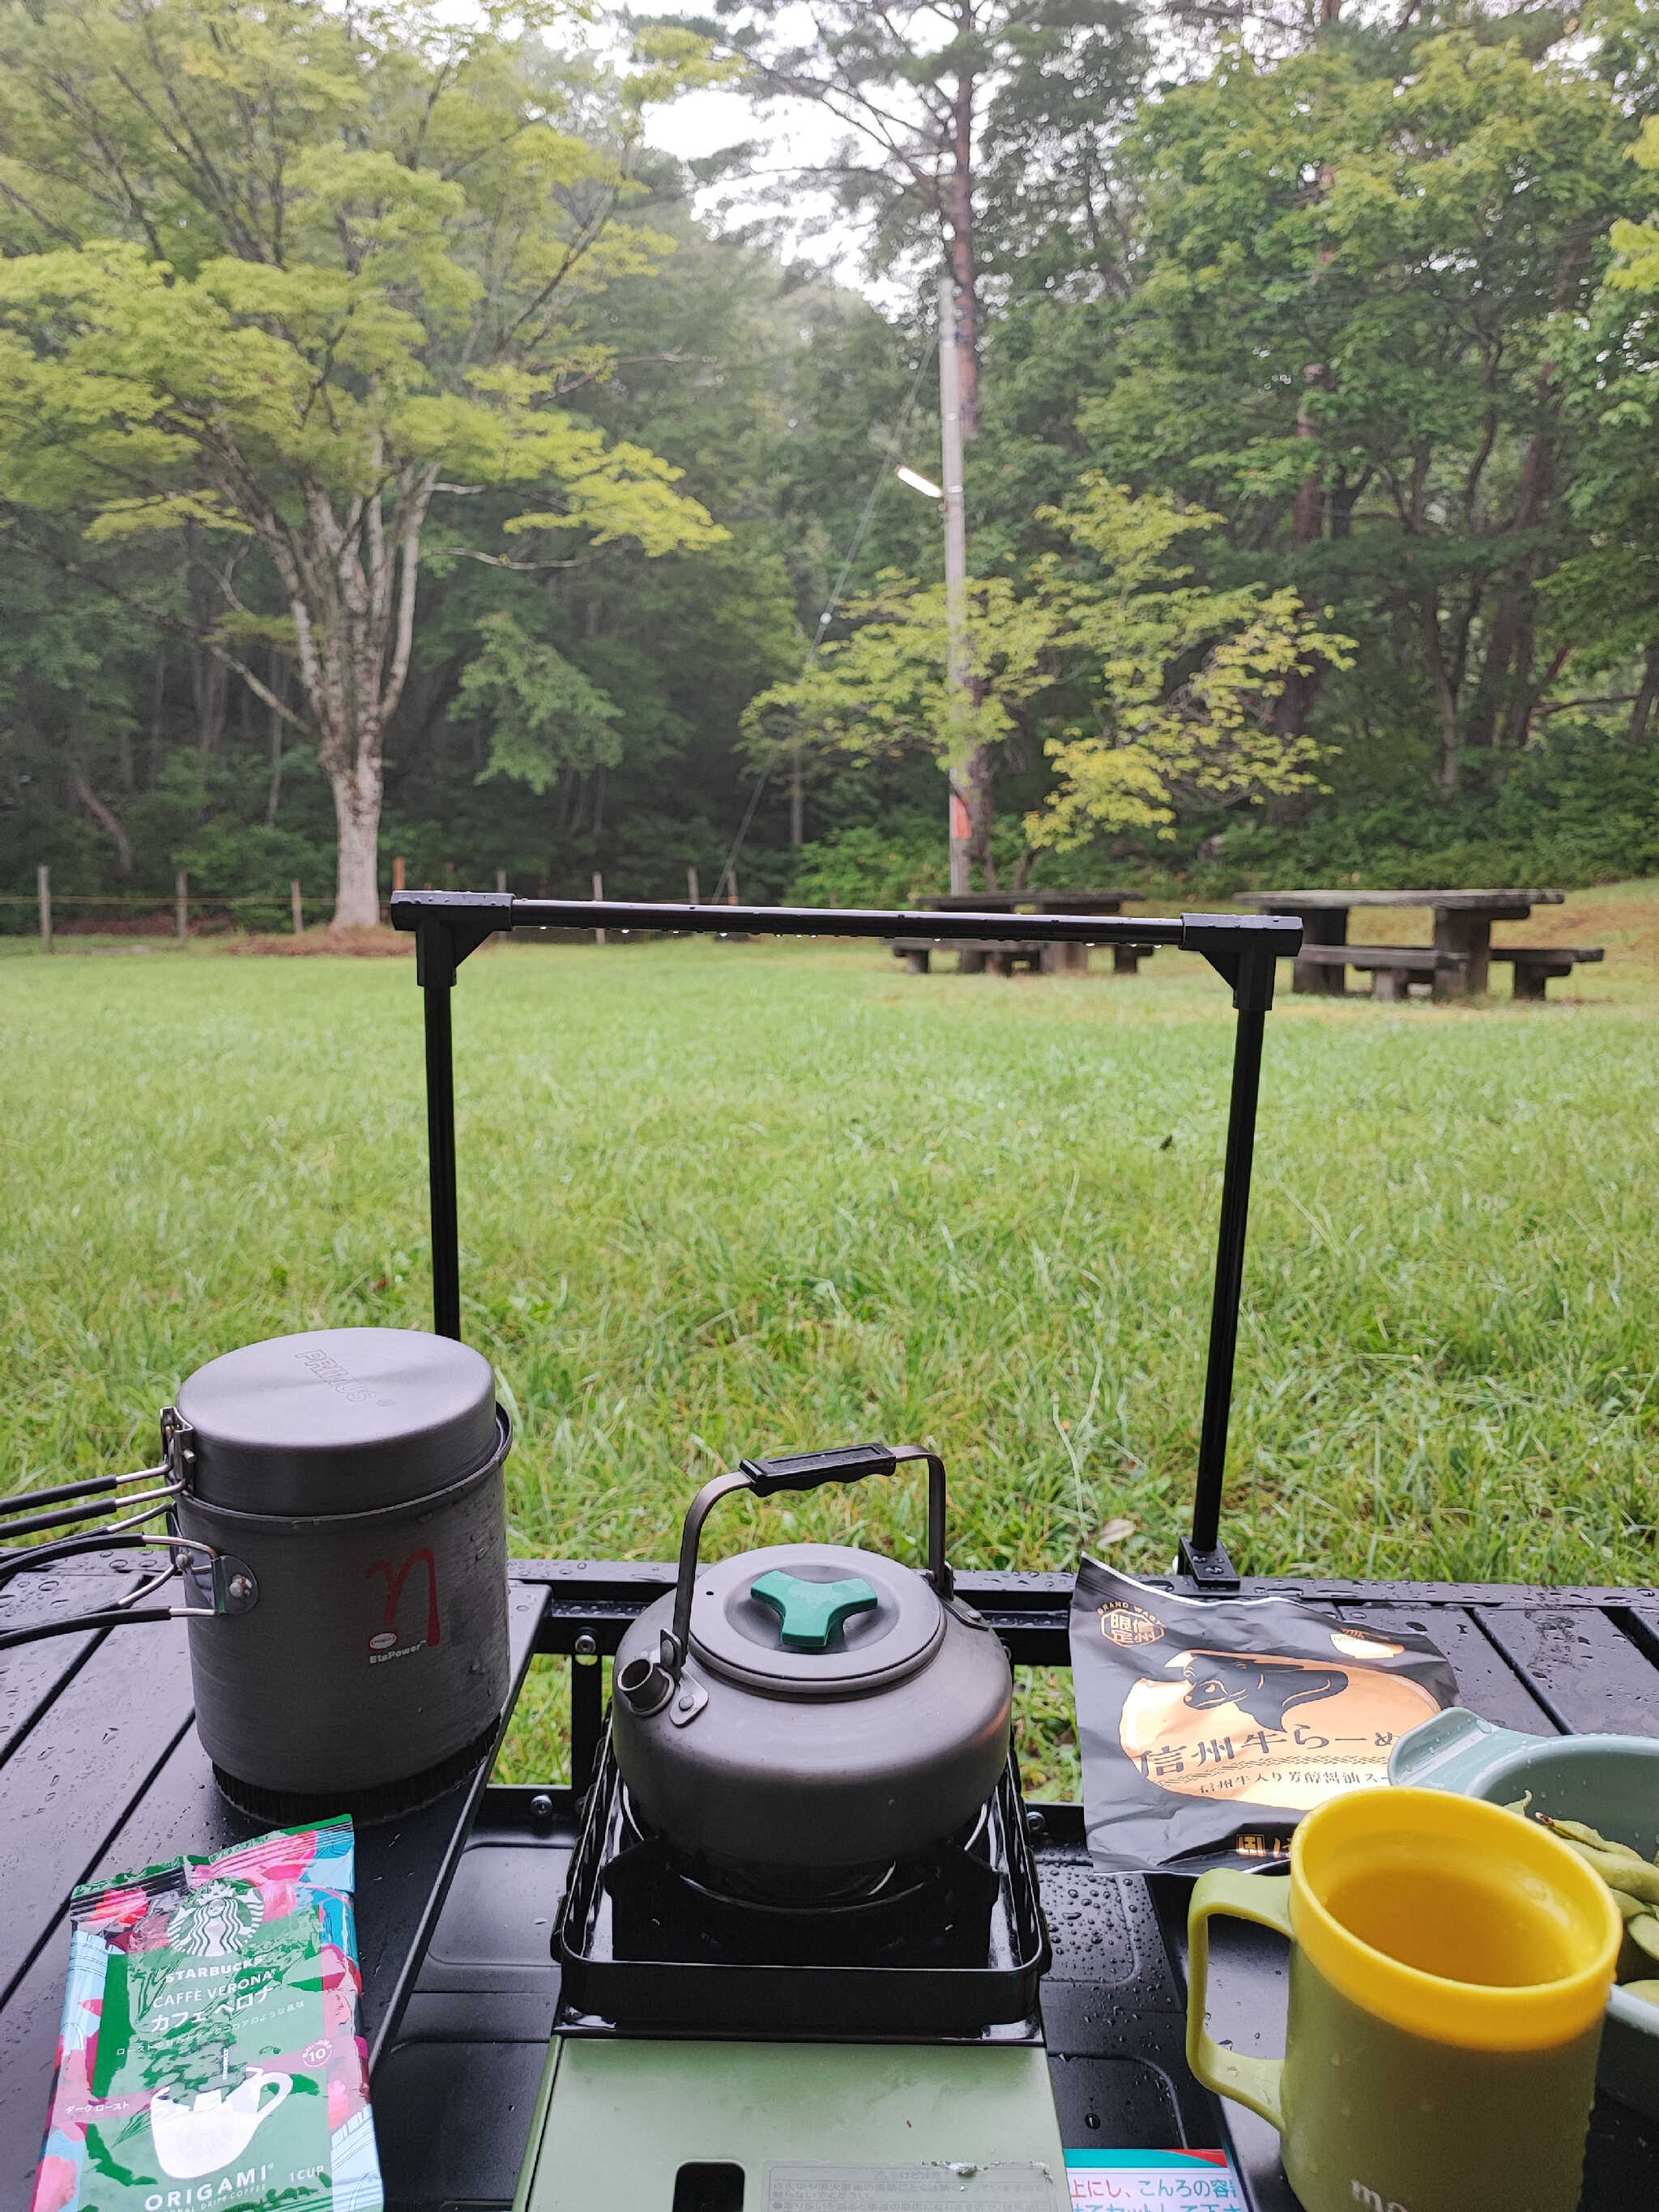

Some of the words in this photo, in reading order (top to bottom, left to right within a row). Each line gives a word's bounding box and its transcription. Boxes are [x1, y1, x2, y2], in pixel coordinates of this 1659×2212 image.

[294, 1349, 376, 1402] PRIMUS
[1097, 1601, 1129, 1615] BRAND
[165, 1955, 264, 1984] STARBUCKS
[152, 1987, 202, 2009] CAFFÈ
[207, 1971, 273, 1999] VERONA
[151, 2010, 208, 2033] カフェ
[309, 2048, 326, 2062] 10
